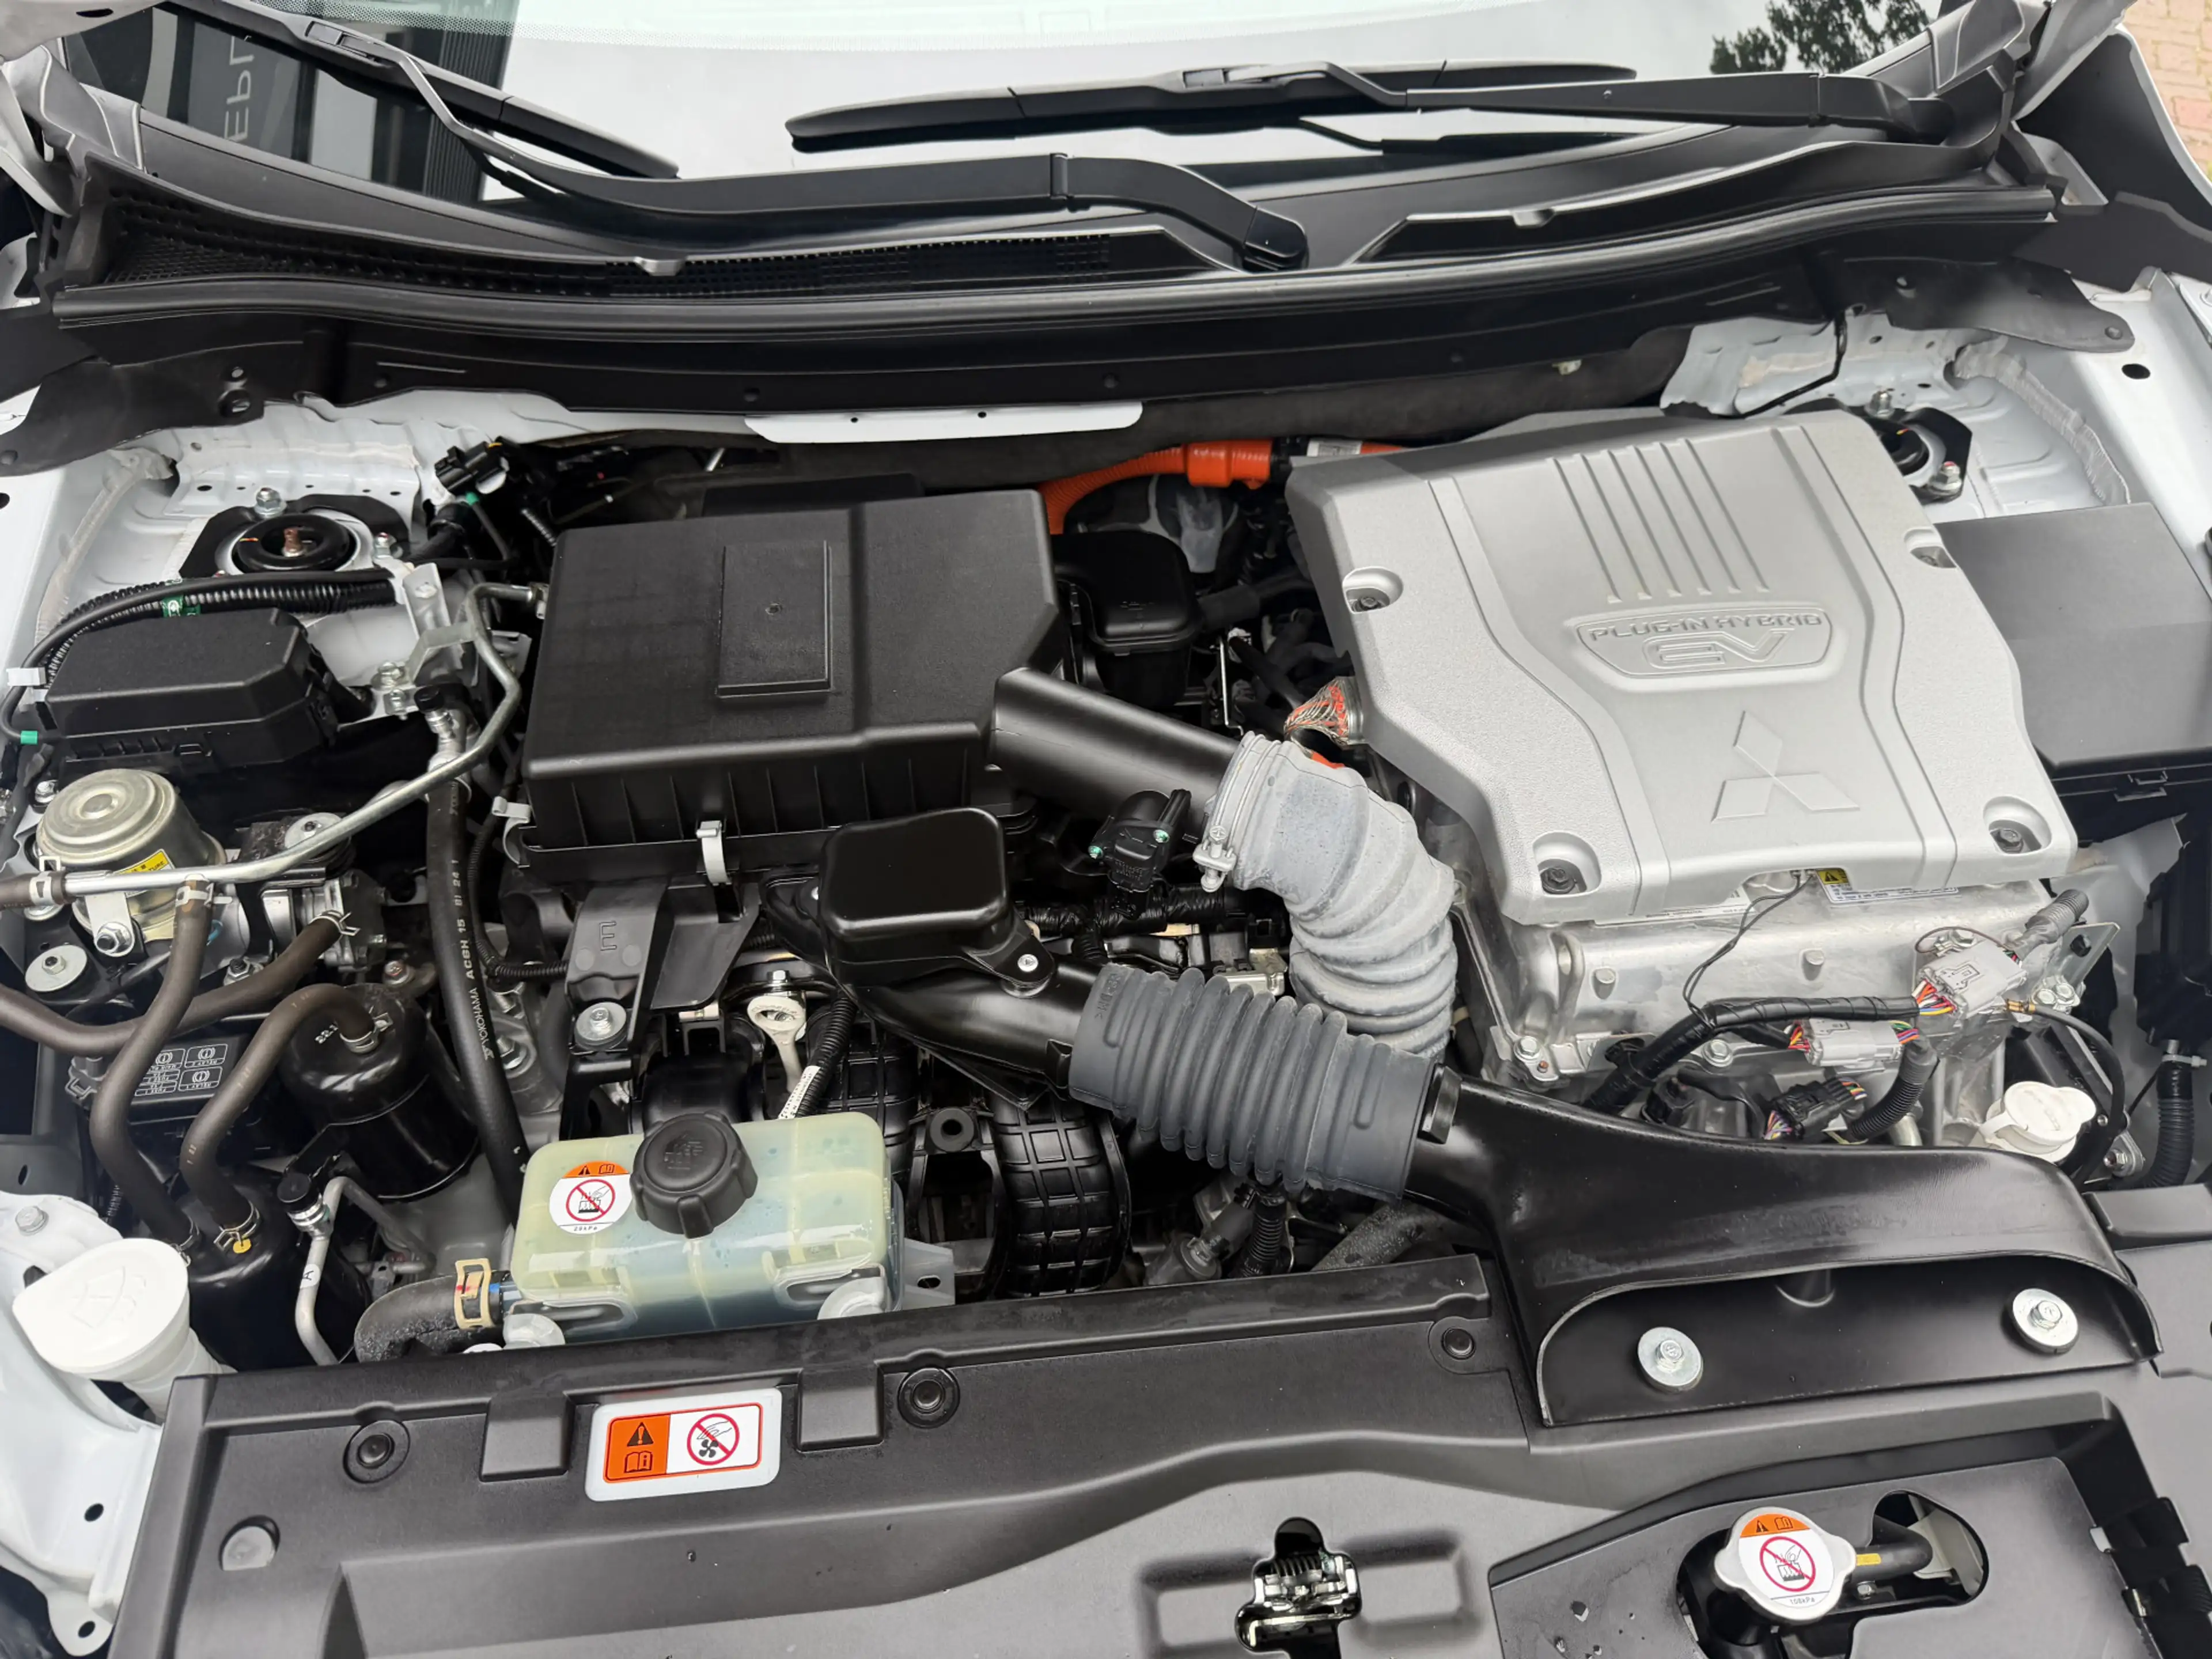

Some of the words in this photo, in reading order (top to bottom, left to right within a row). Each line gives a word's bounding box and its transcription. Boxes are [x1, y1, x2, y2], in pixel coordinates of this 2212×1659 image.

[1588, 617, 1709, 641] PLUG-IN
[1713, 613, 1823, 630] HYBRID
[1643, 627, 1796, 669] EV
[456, 919, 466, 933] 15
[599, 921, 617, 951] E
[468, 986, 490, 1046] YOKOHAMA
[304, 1270, 314, 1281] A
